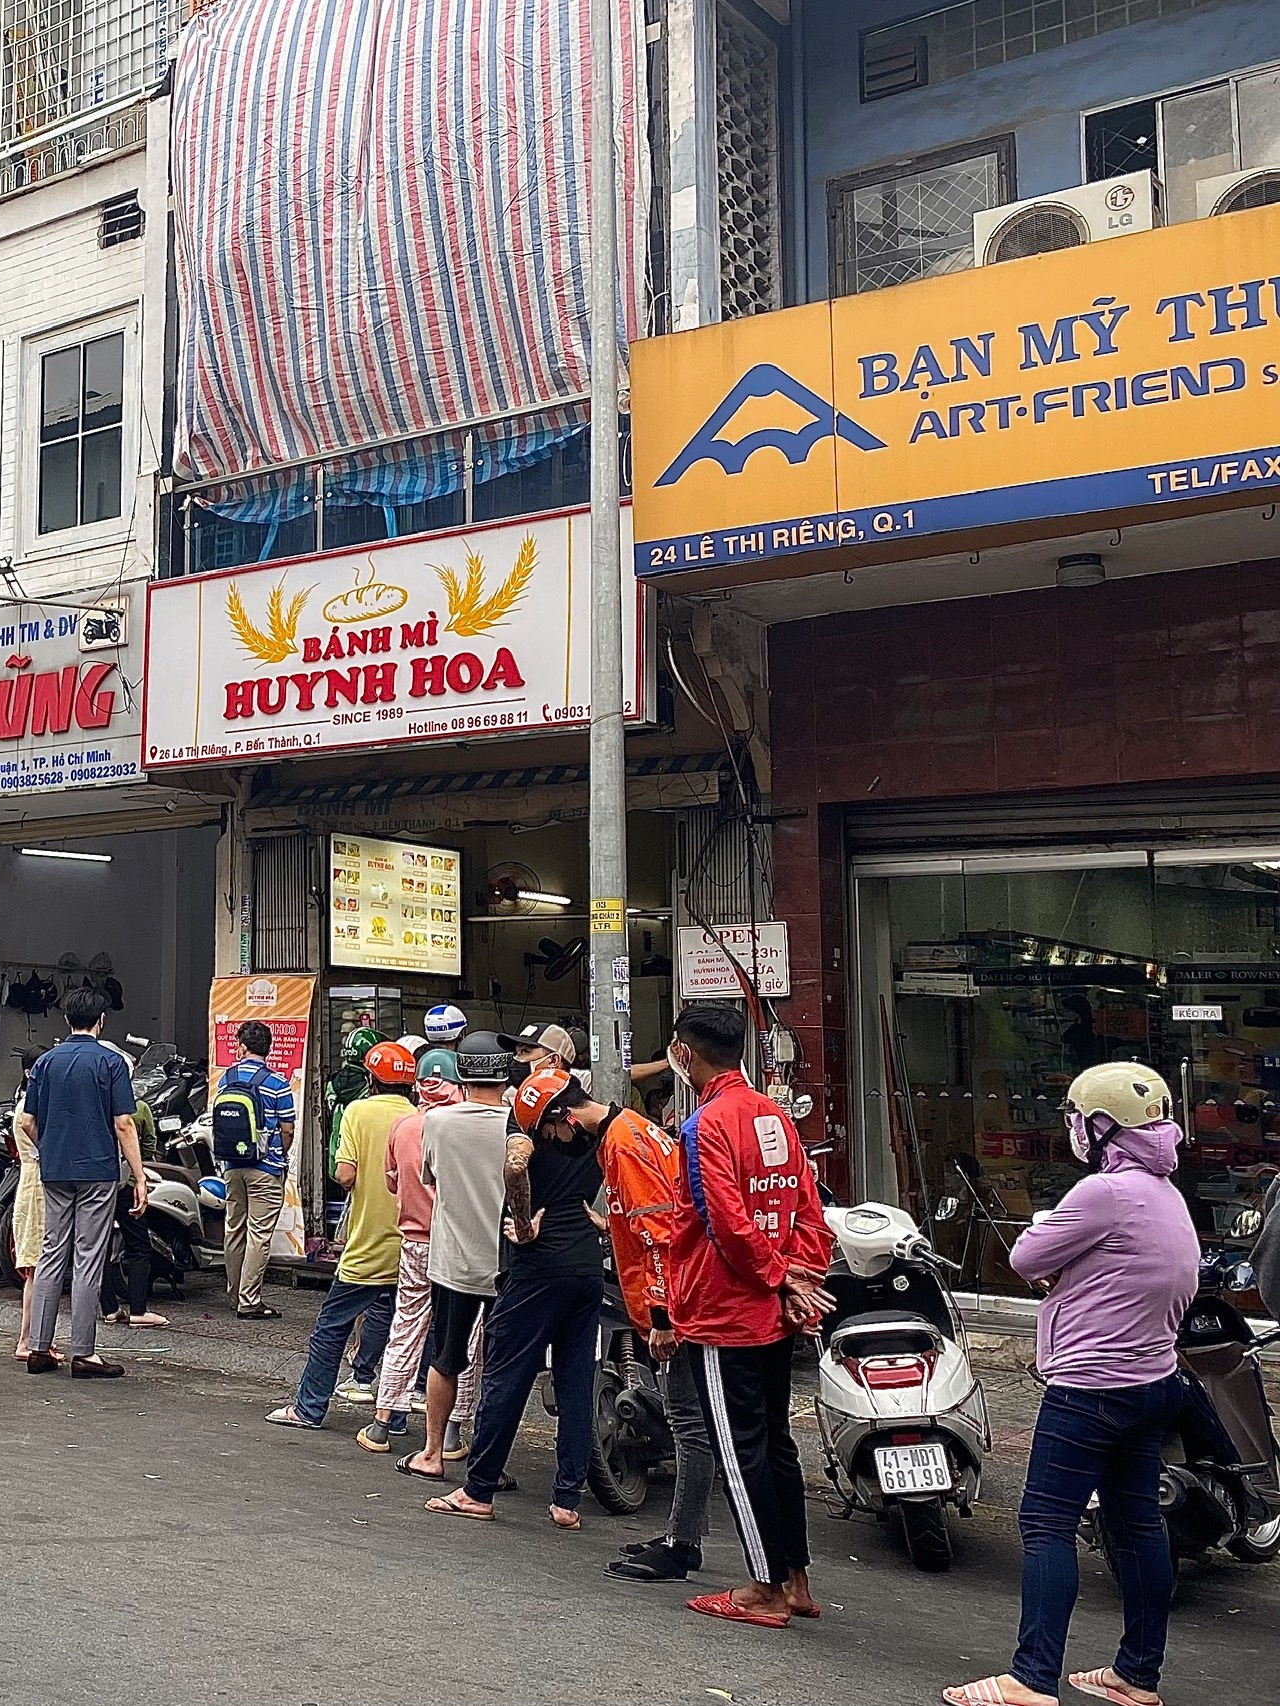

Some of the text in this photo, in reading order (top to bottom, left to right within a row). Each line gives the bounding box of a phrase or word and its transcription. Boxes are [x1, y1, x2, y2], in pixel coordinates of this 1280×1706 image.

[1107, 212, 1131, 229] LG
[857, 330, 998, 401] BẠN
[1017, 295, 1129, 371] MỸ
[650, 510, 915, 568] 24 LÊ THỊ RIÊNG, Q.1
[19, 622, 41, 643] TM
[43, 619, 55, 640] &
[58, 612, 79, 638] DV
[302, 610, 440, 663] BÁNH MÌ
[223, 646, 526, 721] HUYNH HOA
[332, 707, 404, 728] SINCE 1989
[408, 710, 528, 736] Hotline 08 96 69 88 11
[159, 747, 171, 761] 26
[172, 746, 184, 759] Lê
[185, 744, 199, 759] Thị
[234, 740, 244, 754] P.
[246, 735, 265, 752] Bến
[267, 733, 302, 751] Thành,
[303, 732, 321, 747] Q.1
[33, 757, 49, 770] TP.
[51, 751, 65, 768] Hồ
[67, 750, 84, 766] Chí
[86, 749, 112, 764] Minh
[1, 771, 64, 789] 0903825628
[70, 761, 137, 782] 0908223032
[716, 965, 730, 974] HOA
[980, 972, 1013, 983] DALER
[1175, 968, 1280, 980] DALER ROWNEY
[765, 977, 784, 992] giờ
[1177, 1006, 1218, 1018] KÉO RA
[884, 1467, 946, 1490] 681.98
